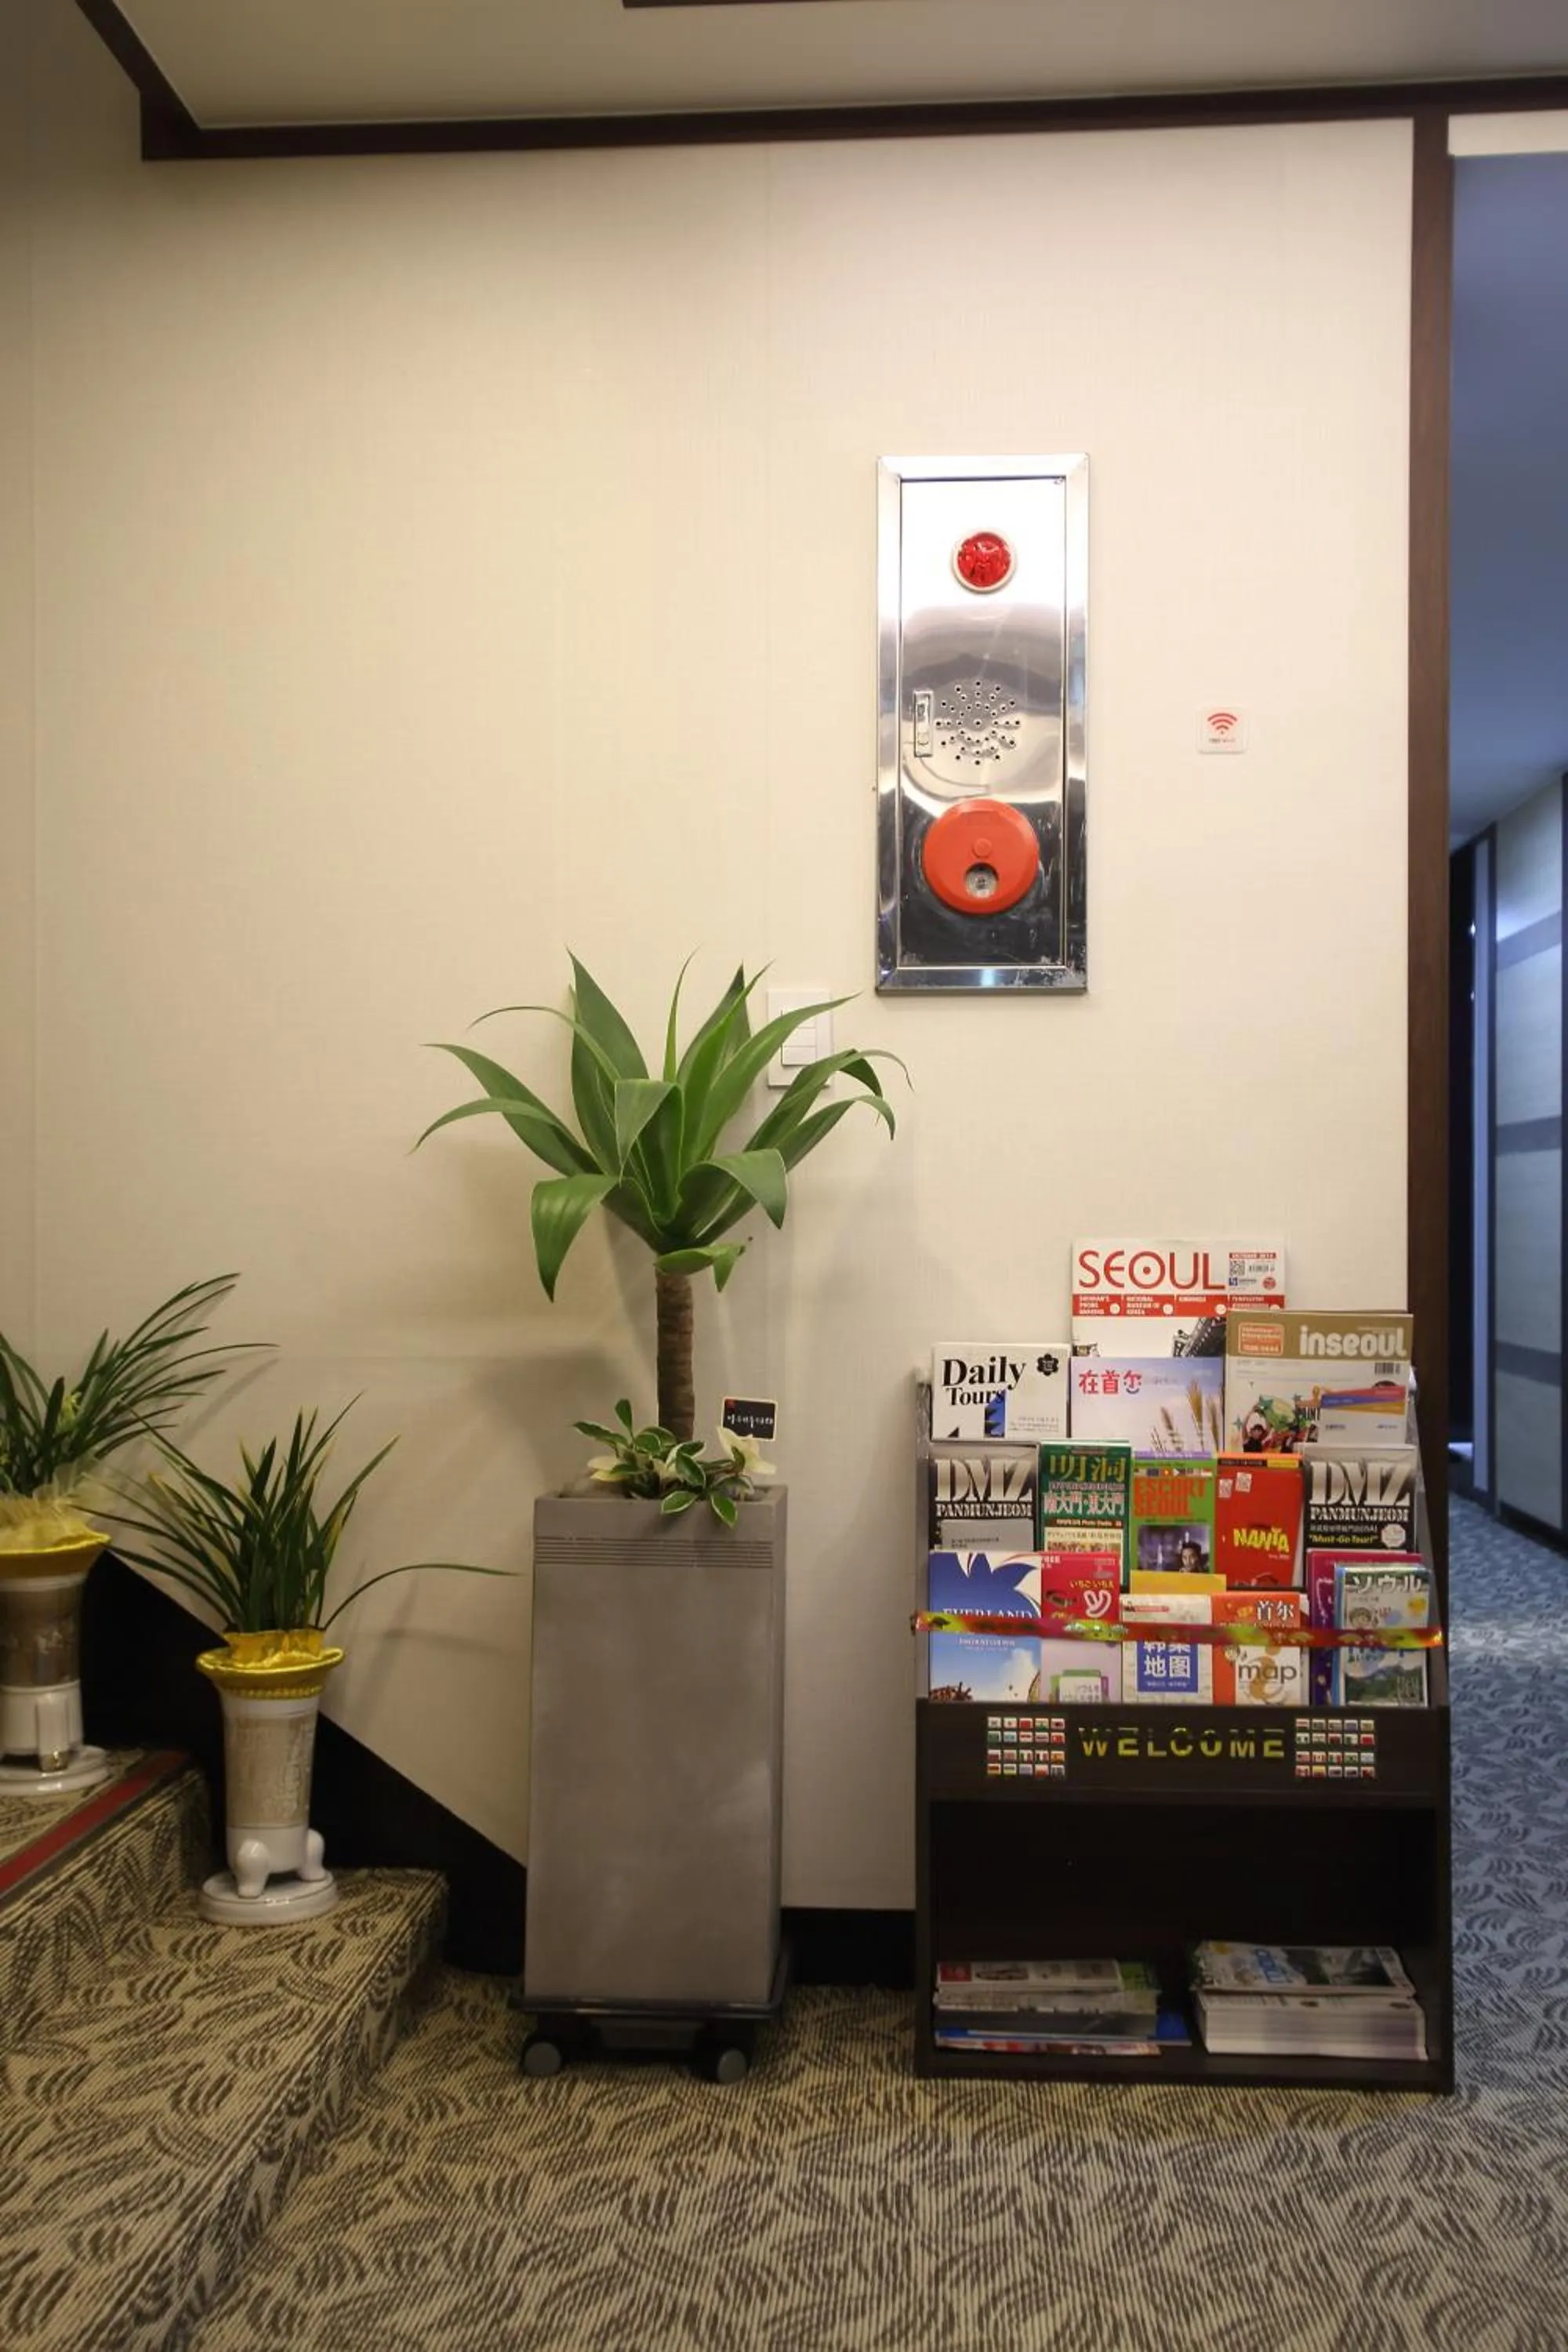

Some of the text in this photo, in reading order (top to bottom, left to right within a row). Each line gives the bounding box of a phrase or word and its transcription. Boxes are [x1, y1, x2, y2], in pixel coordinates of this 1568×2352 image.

[1078, 1250, 1225, 1290] SEOUL
[1299, 1325, 1406, 1357] inseoul
[942, 1356, 1026, 1389] Daily
[1078, 1369, 1142, 1394] 在首尔
[946, 1387, 1006, 1406] Tours
[934, 1459, 1033, 1502] DMZ
[1308, 1461, 1411, 1506] DMZ
[935, 1503, 1033, 1518] PANMUNJEOM
[1308, 1508, 1409, 1523] PANMUNJEOM
[1238, 1663, 1298, 1686] map
[1078, 1727, 1286, 1758] WELCOME
